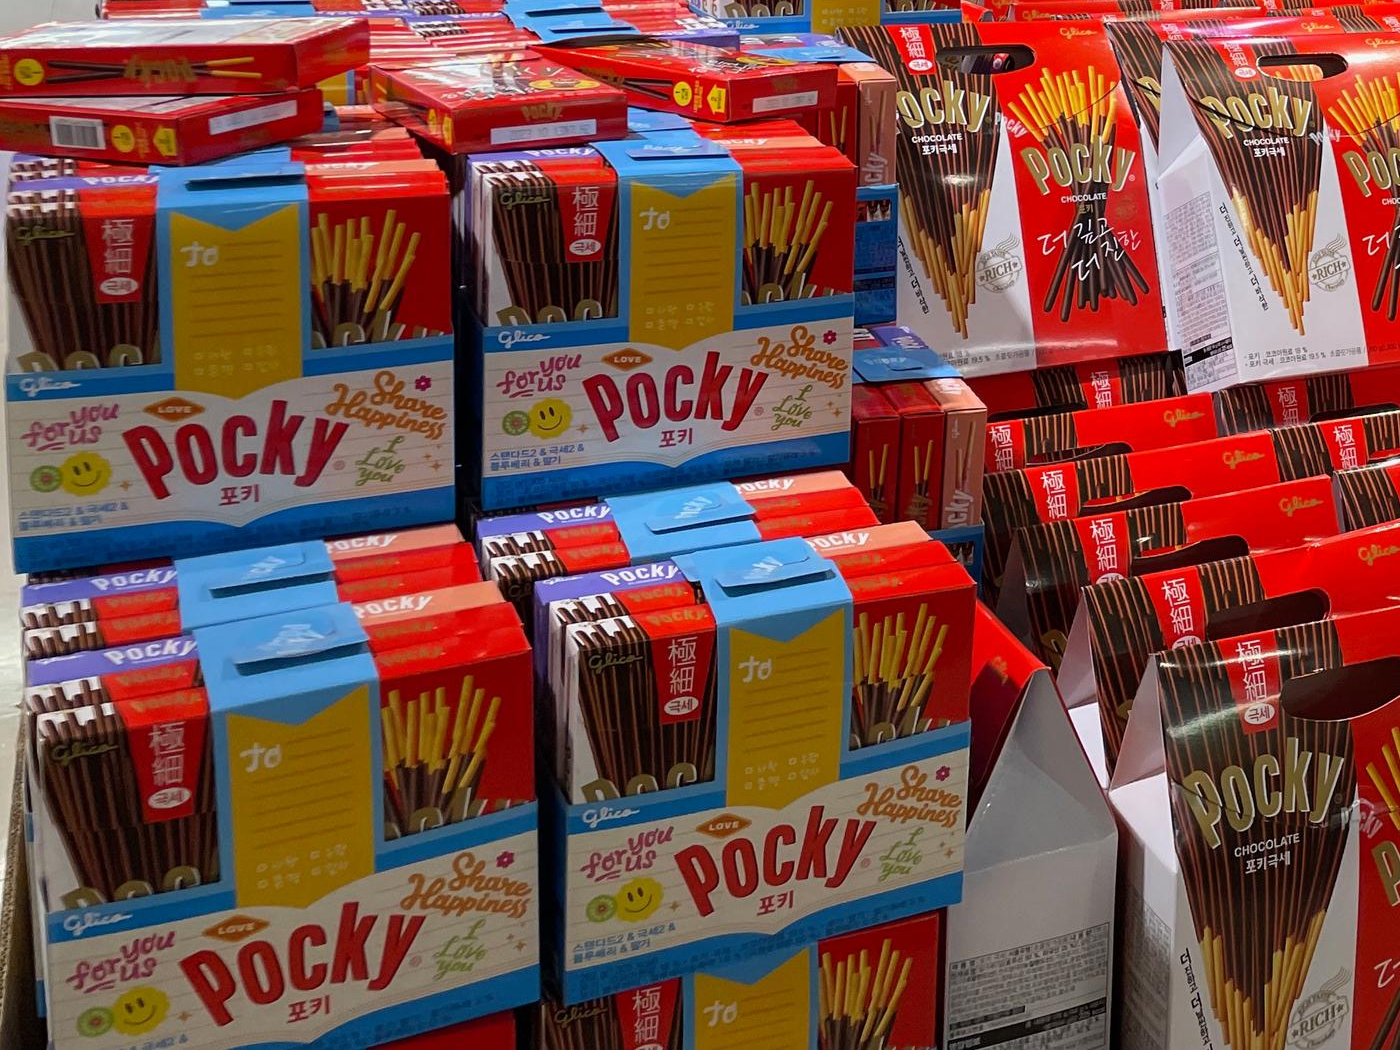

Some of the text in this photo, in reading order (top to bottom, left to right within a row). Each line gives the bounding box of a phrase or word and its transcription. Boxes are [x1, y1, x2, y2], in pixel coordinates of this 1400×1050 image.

[899, 26, 926, 58] 極細
[1201, 82, 1314, 138] Pocky
[911, 132, 963, 144] CHOCOLATE
[921, 143, 957, 157] 포키극세
[1243, 137, 1290, 148] CHOCOLATE
[1020, 135, 1137, 197] Pocky
[499, 192, 552, 209] Glico
[571, 185, 599, 238] 極細
[1060, 192, 1107, 204] CHOCOLATE
[1362, 231, 1394, 256] 더
[984, 261, 1014, 278] RICH
[497, 331, 552, 348] Glico
[786, 325, 850, 371] Share
[496, 353, 583, 397] for you
[612, 355, 641, 364] LOVE
[750, 337, 847, 389] Happiness
[536, 373, 567, 393] us
[582, 351, 769, 444] Pocky
[122, 399, 350, 500] Pocky
[658, 428, 694, 449] 포키
[600, 560, 679, 587] Pocky
[668, 637, 698, 696] 極細
[1235, 638, 1268, 702] 極細
[1247, 707, 1273, 723] 극세
[149, 722, 186, 786] 極細
[898, 765, 964, 811] Share
[1182, 737, 1346, 849] Pocky
[582, 806, 641, 828] Glico
[856, 782, 962, 829] Happiness
[674, 805, 877, 918] Pocky
[1233, 832, 1301, 859] CHOCOLATE
[1244, 850, 1291, 875] 포키극세
[179, 902, 426, 1027] Pocky
[286, 995, 331, 1023] 포키
[1298, 1005, 1336, 1038] RICH
